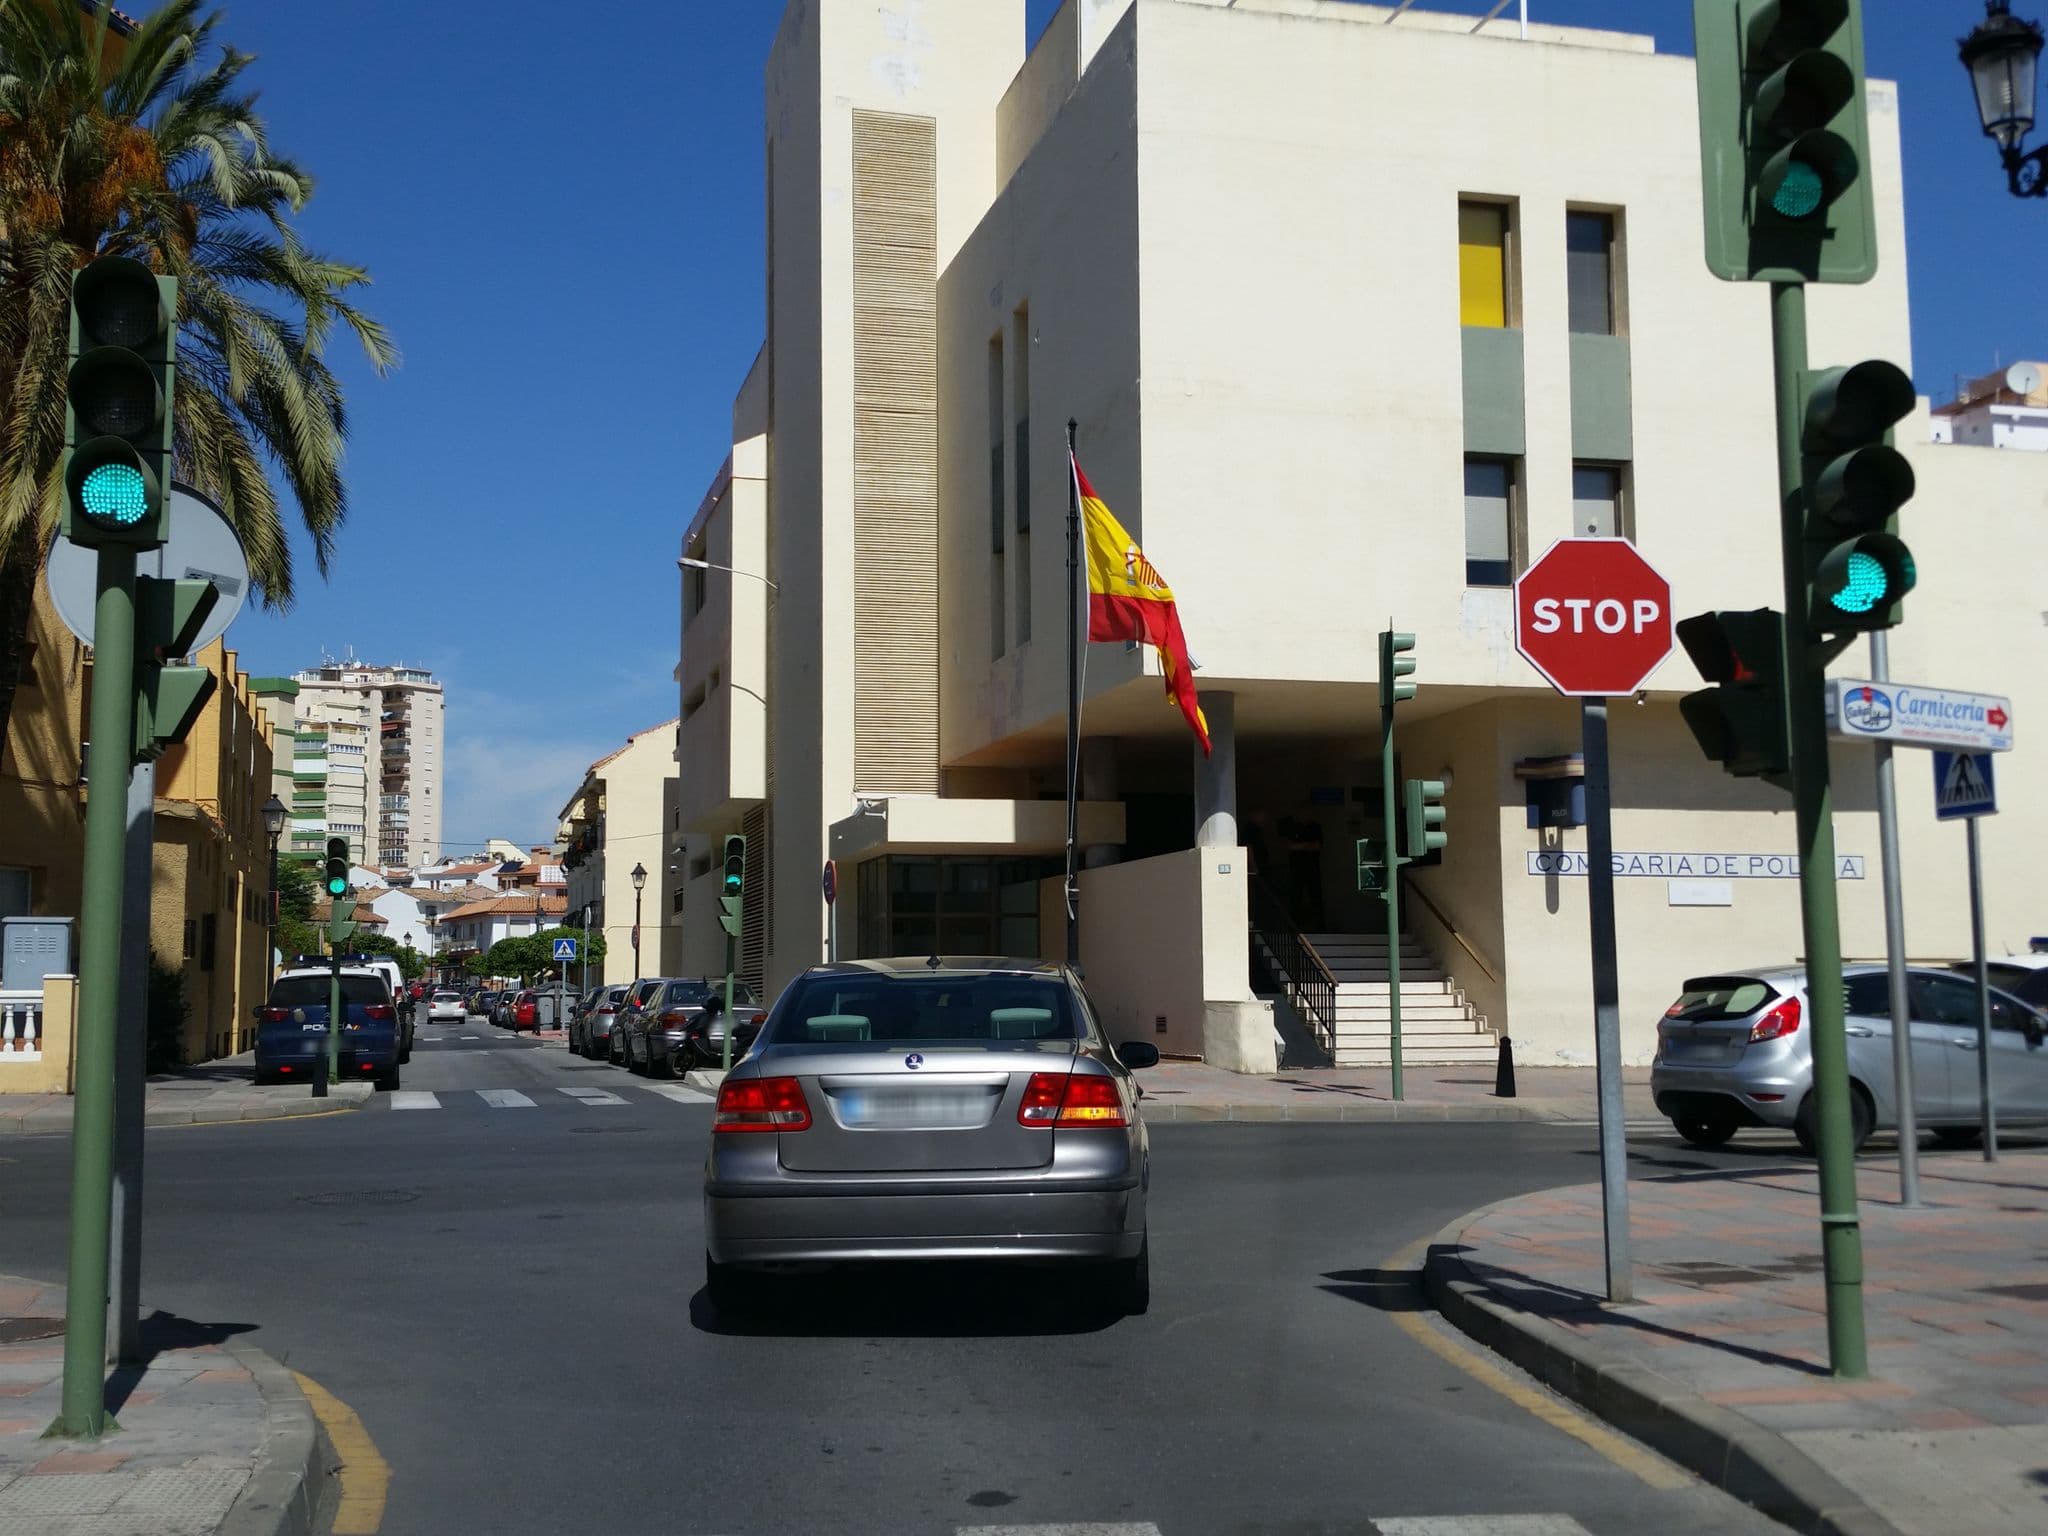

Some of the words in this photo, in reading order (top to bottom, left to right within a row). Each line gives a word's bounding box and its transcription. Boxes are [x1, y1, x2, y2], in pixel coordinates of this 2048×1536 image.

[1532, 598, 1660, 634] STOP
[1895, 690, 1985, 721] Carnicería
[1536, 854, 1693, 875] COMSARIA
[1704, 856, 1739, 875] DE
[1749, 857, 1857, 876] POLA
